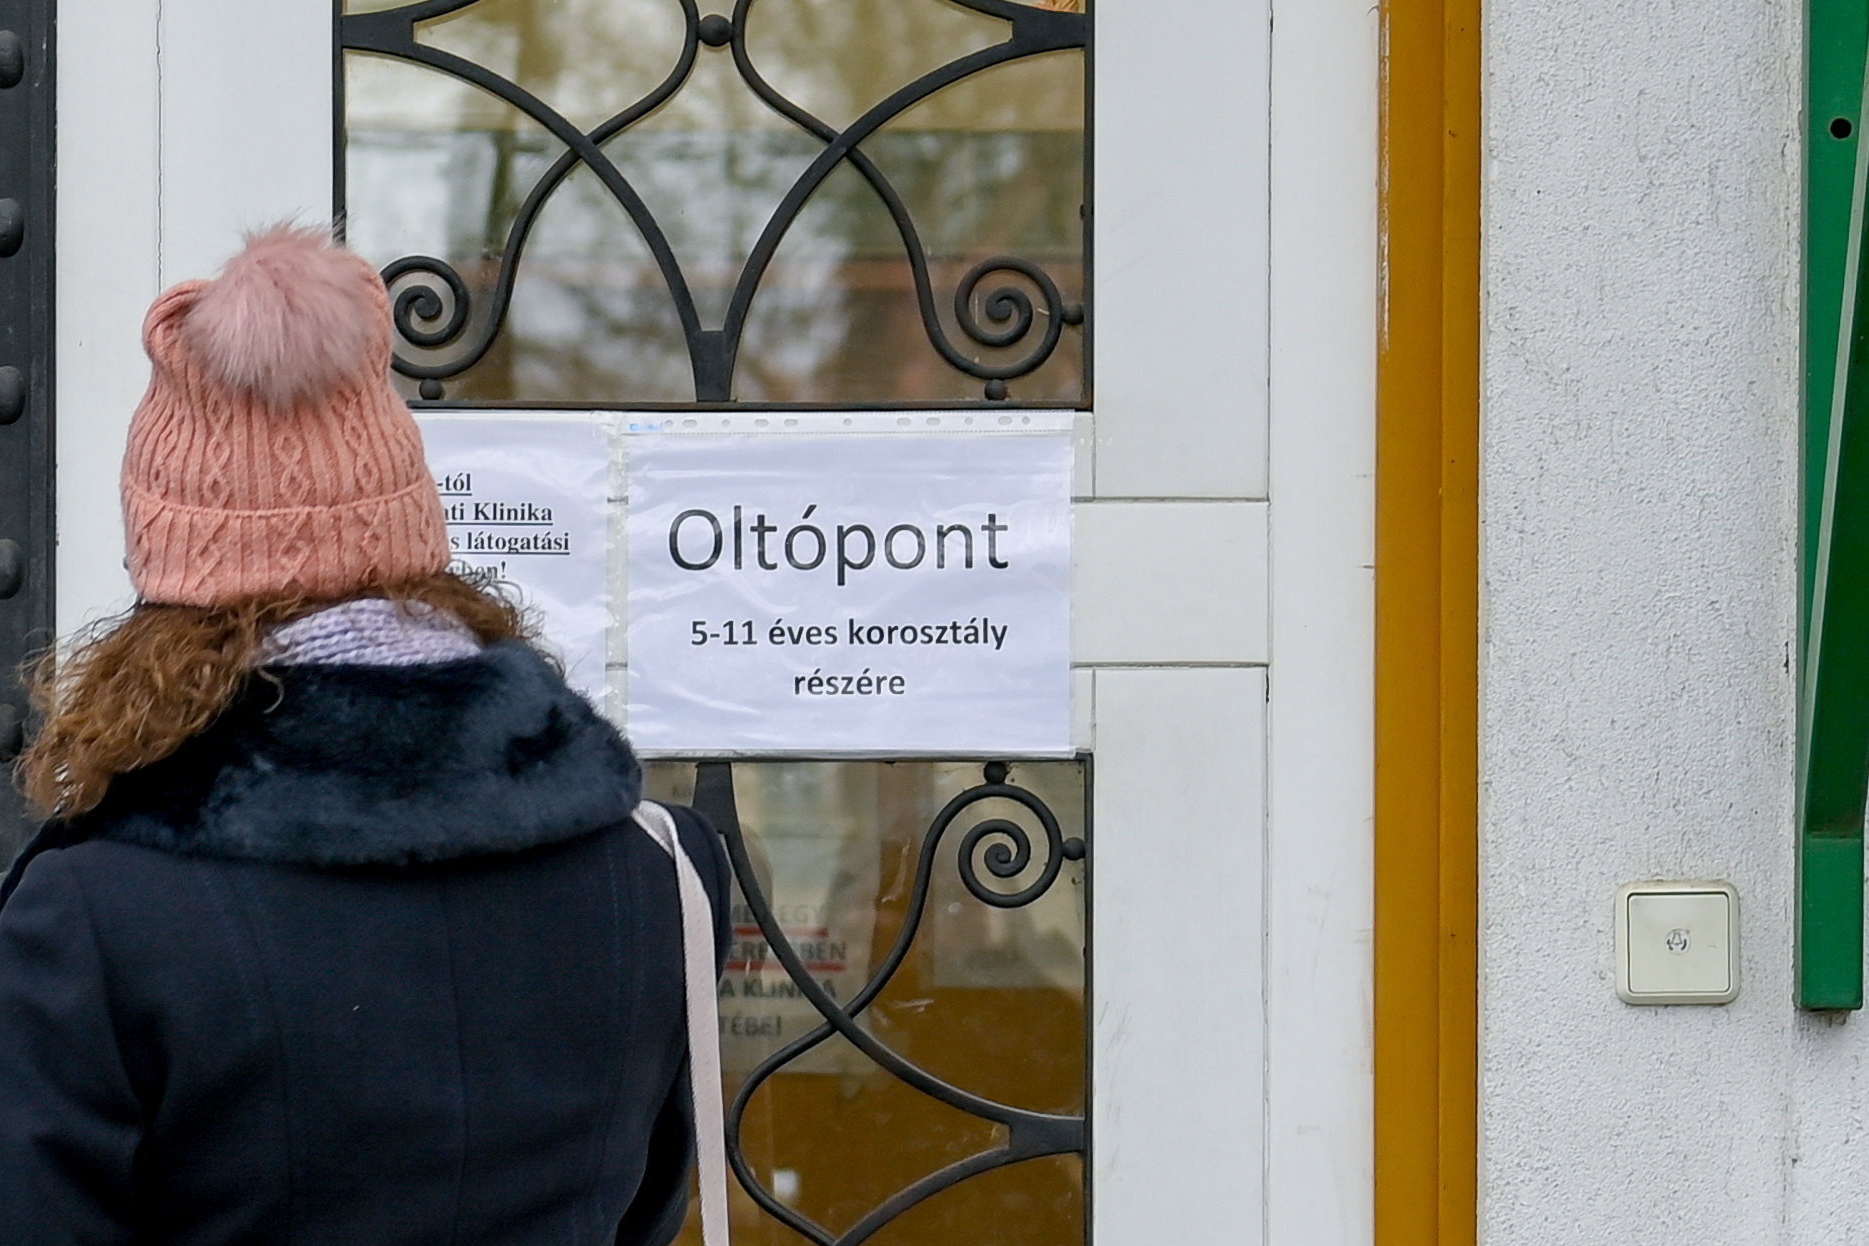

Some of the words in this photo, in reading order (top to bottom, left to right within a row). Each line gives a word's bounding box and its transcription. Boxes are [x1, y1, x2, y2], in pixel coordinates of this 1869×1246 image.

[436, 472, 472, 492] -tól
[473, 502, 553, 521] Klinika
[467, 531, 569, 554] látogatási
[668, 504, 1011, 586] Oltópont
[690, 618, 759, 646] 5-11
[767, 617, 838, 646] éves
[847, 617, 1010, 650] korosztály
[792, 669, 907, 696] részére
[743, 979, 836, 998] KLINA
